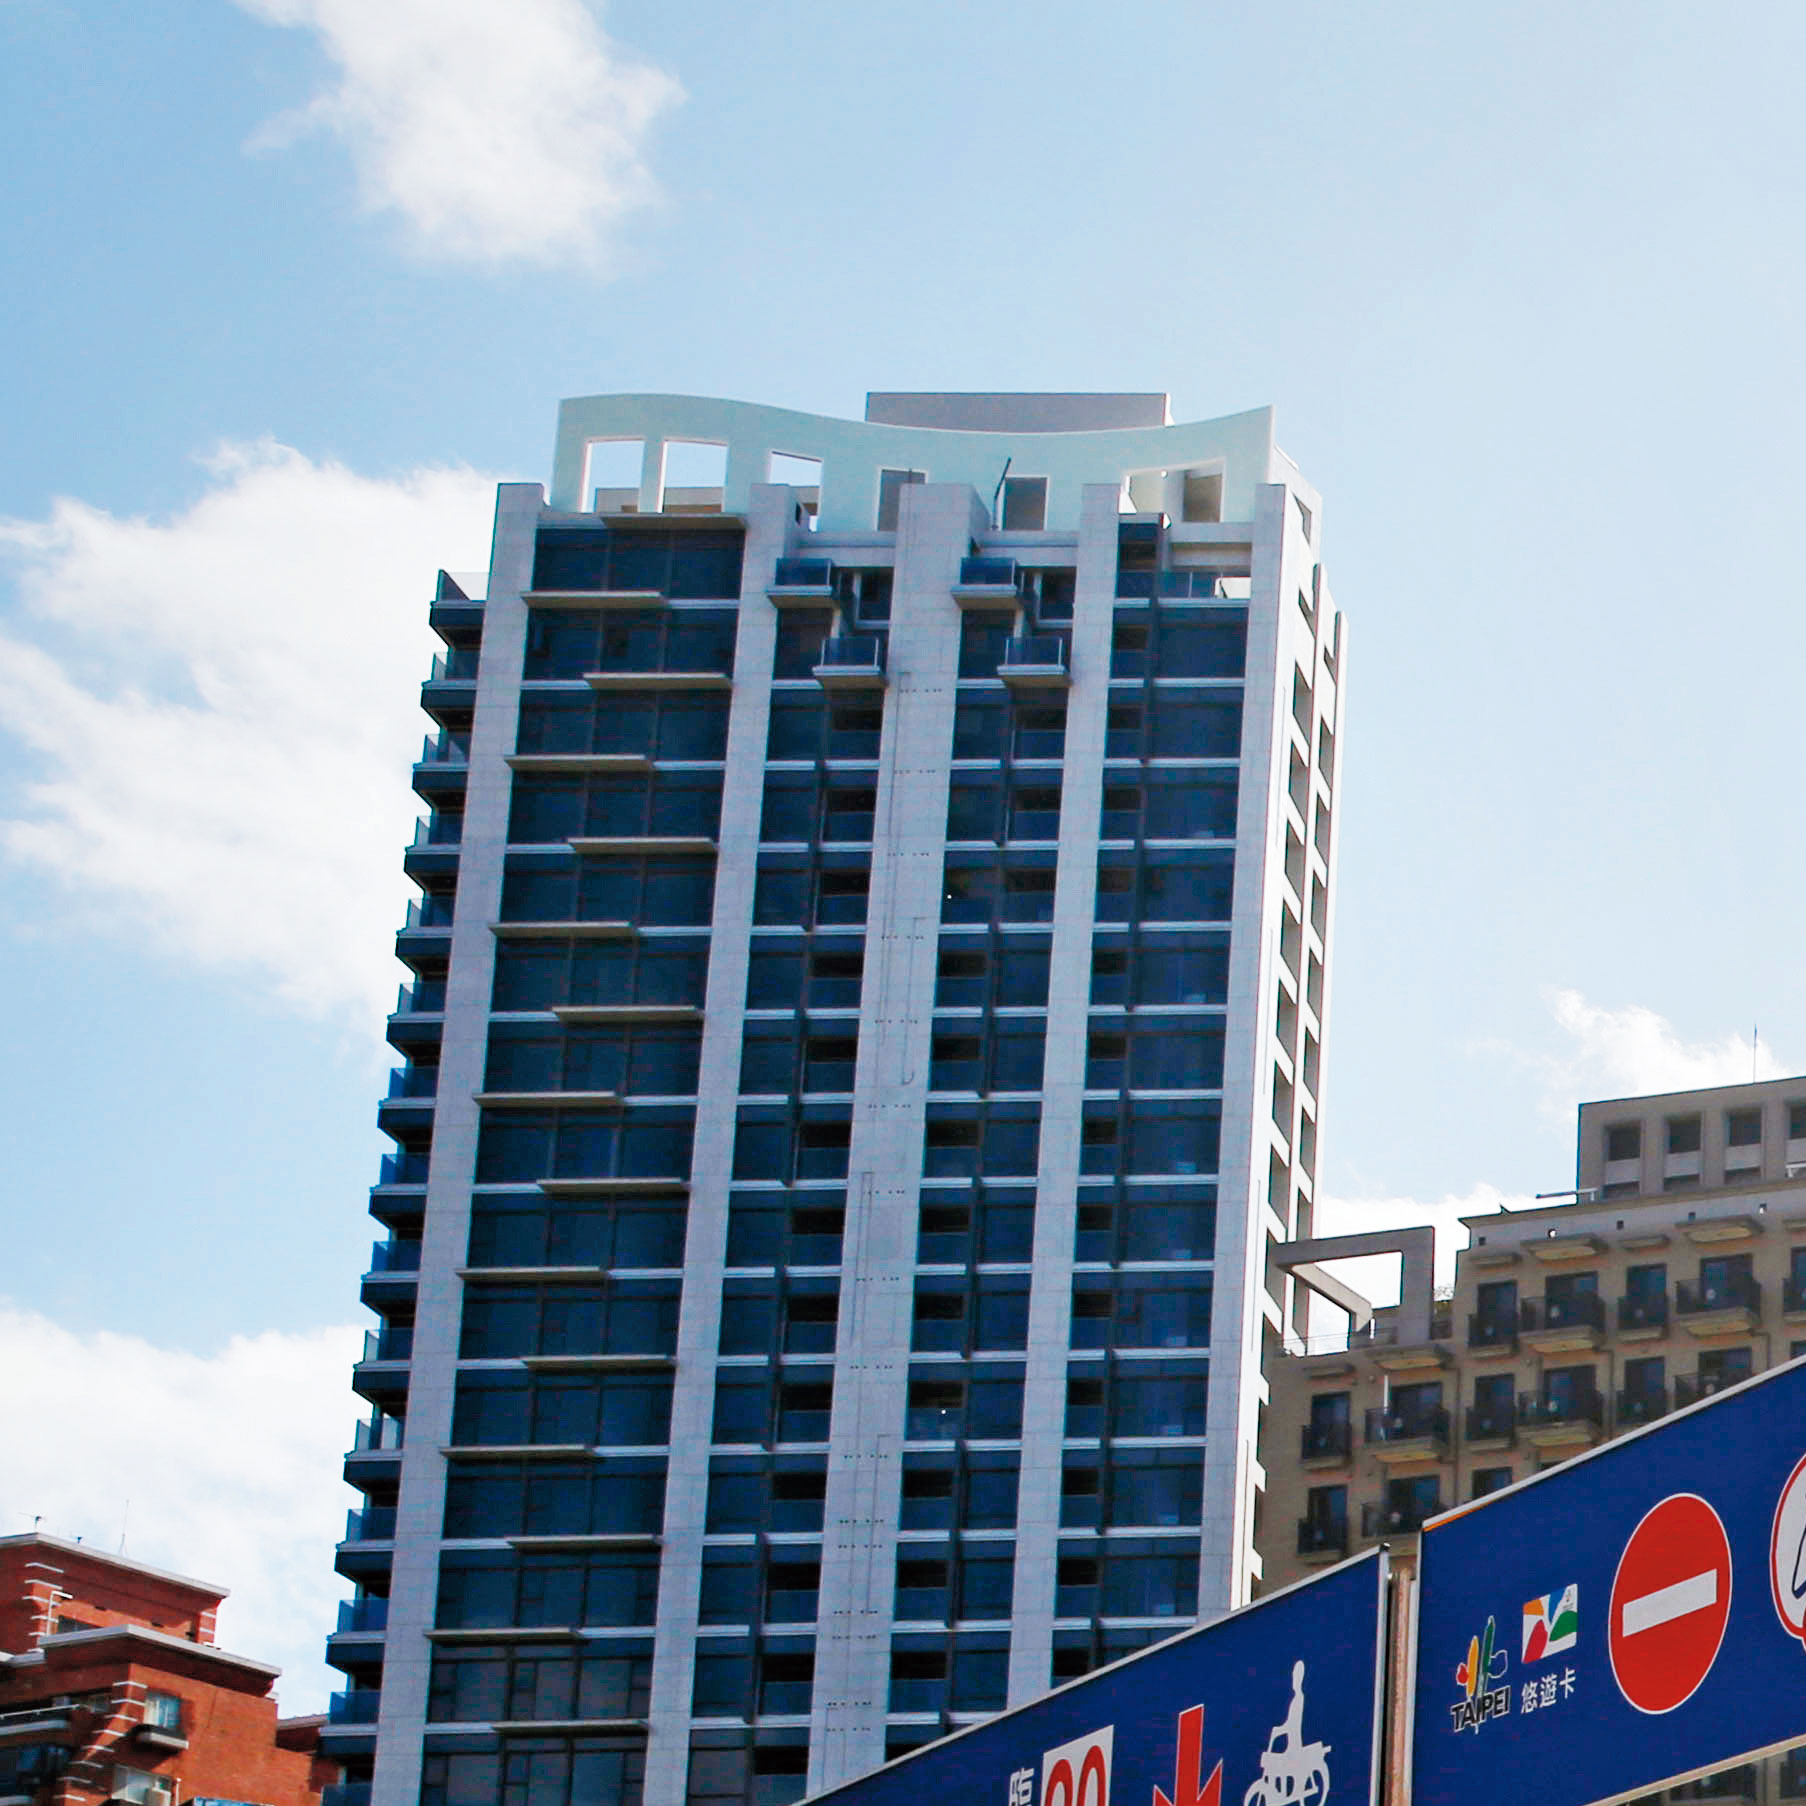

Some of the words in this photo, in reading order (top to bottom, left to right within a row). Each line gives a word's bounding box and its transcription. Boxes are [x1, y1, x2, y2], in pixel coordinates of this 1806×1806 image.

[1451, 1685, 1511, 1732] TAIPEI
[1521, 1667, 1576, 1714] 悠遊卡
